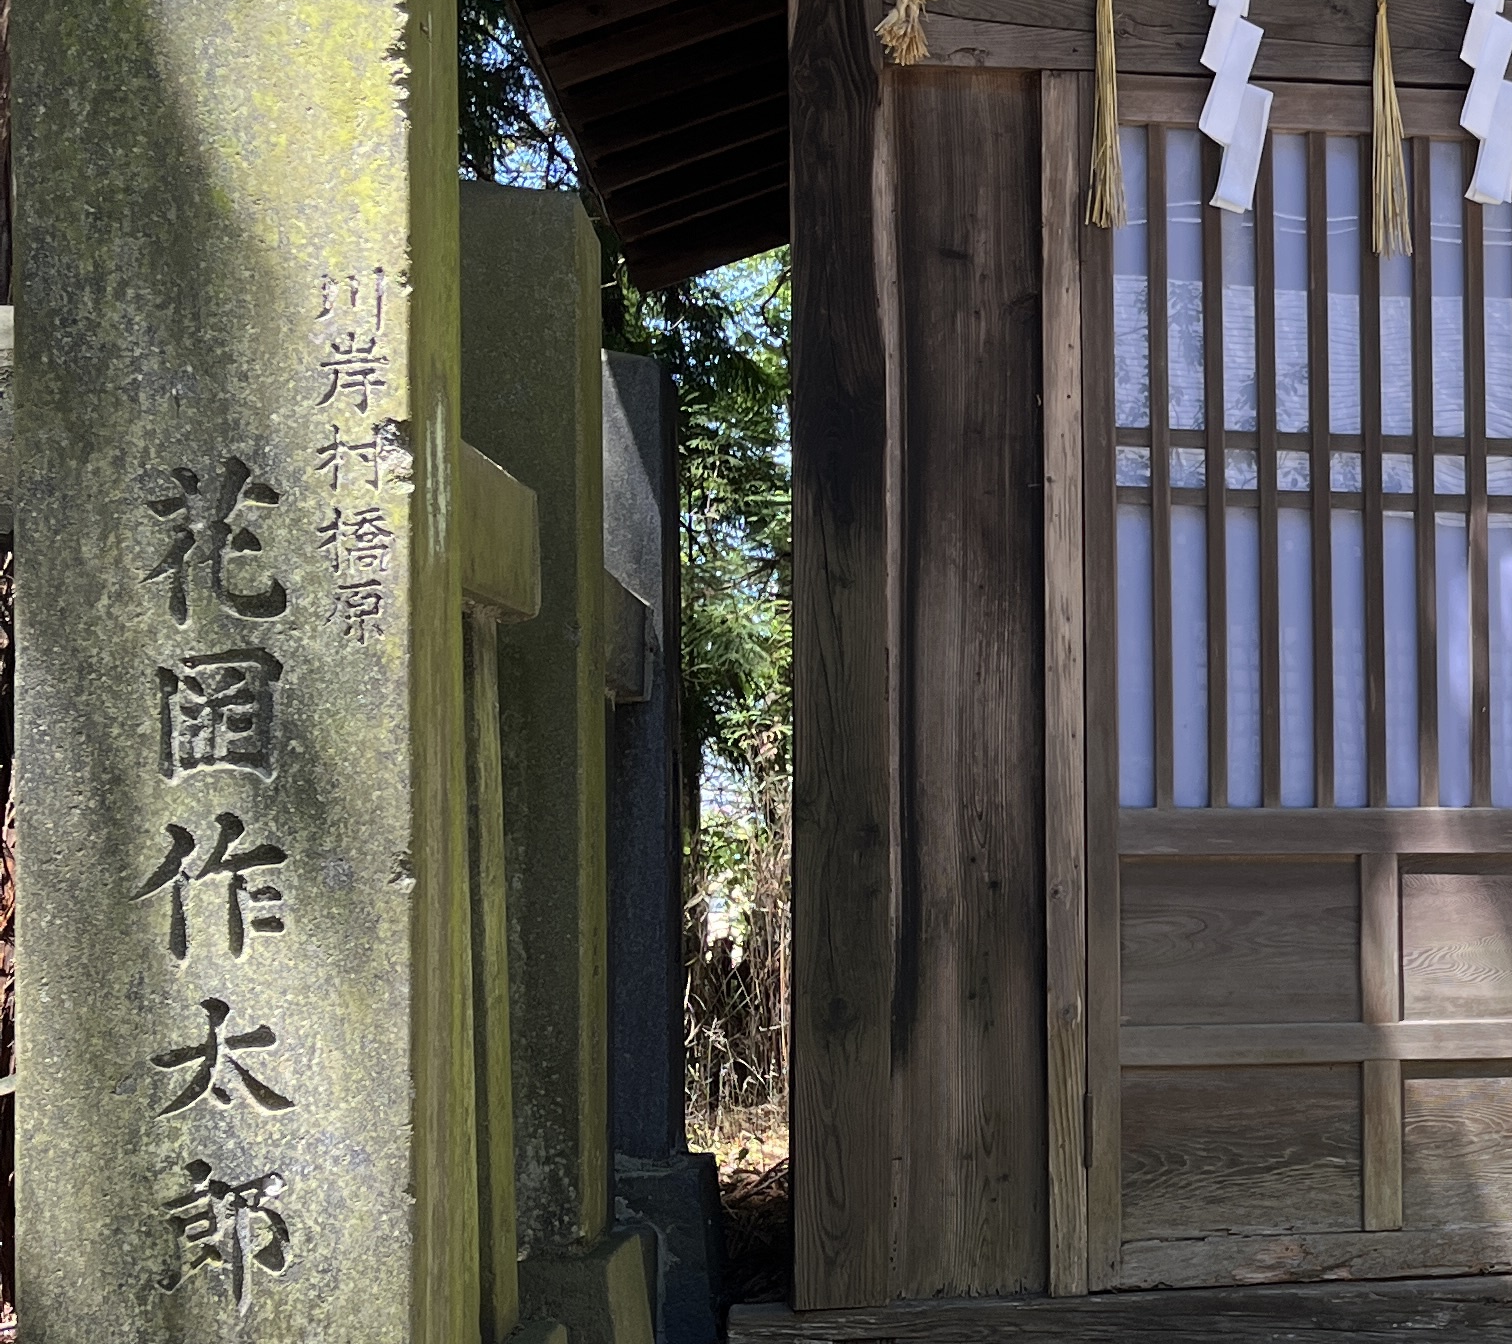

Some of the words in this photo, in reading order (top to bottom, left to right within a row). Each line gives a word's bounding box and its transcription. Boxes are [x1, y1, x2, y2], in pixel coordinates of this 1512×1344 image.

[313, 265, 396, 646] 川岸村橋原
